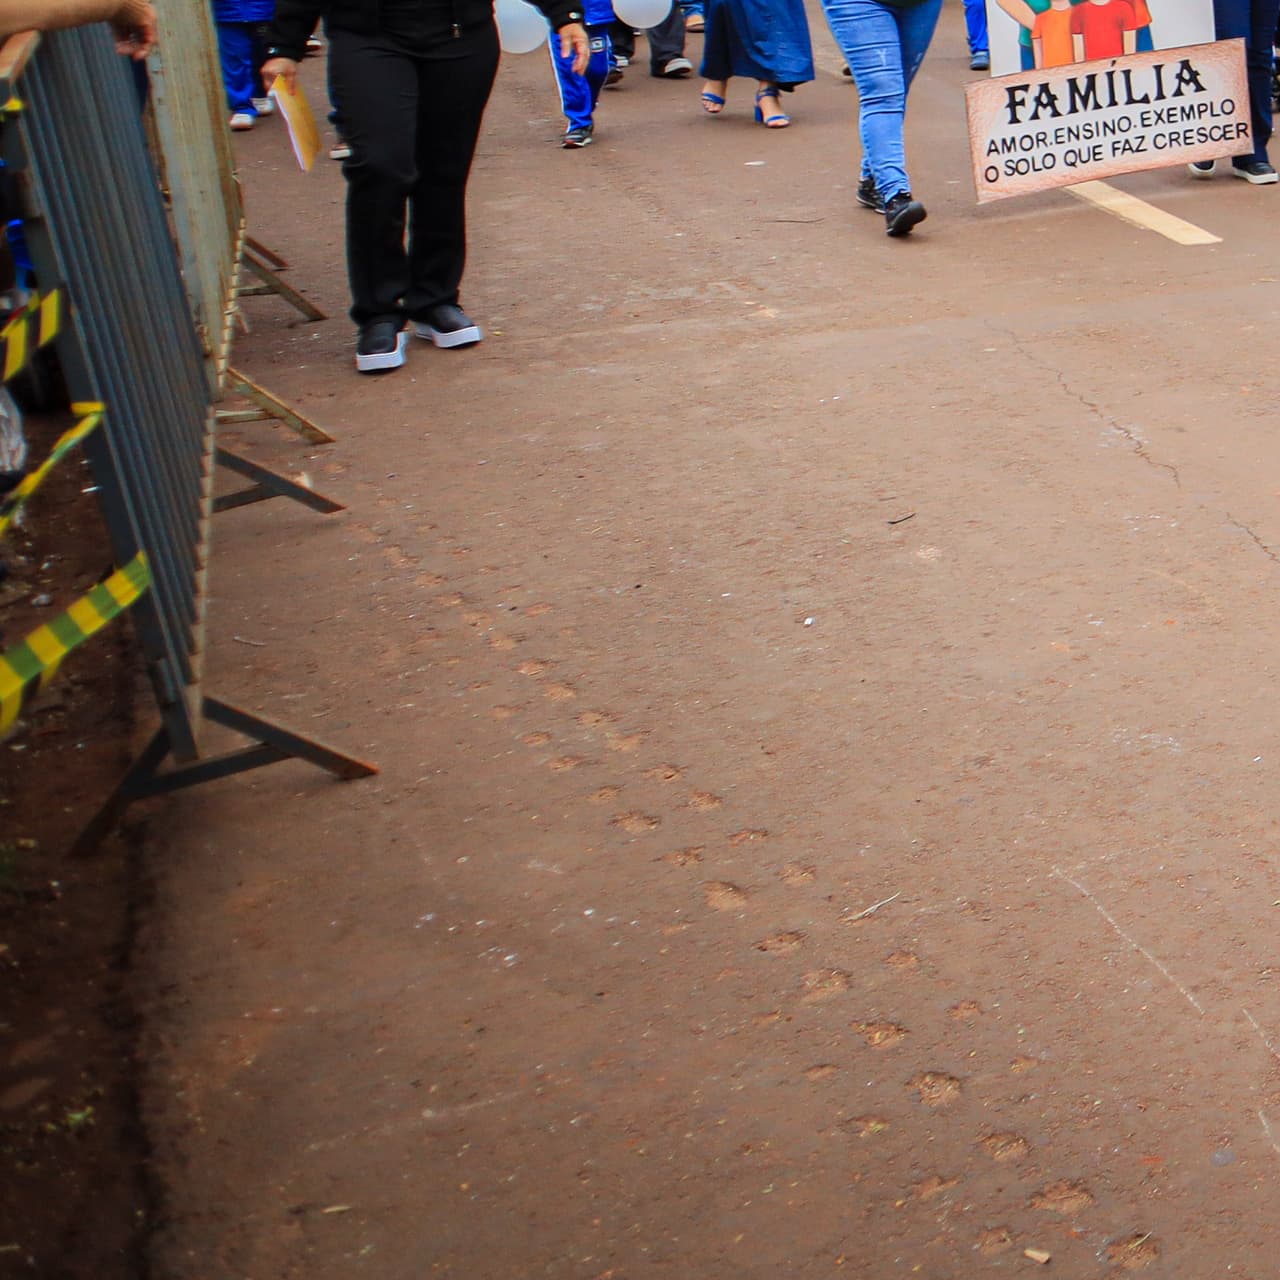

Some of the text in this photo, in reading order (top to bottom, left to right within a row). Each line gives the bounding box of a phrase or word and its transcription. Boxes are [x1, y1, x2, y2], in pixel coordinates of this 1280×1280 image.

[1004, 59, 1207, 125] FAMÍLIA
[984, 123, 1249, 183] O SOLO QUE FAZ CRESCER
